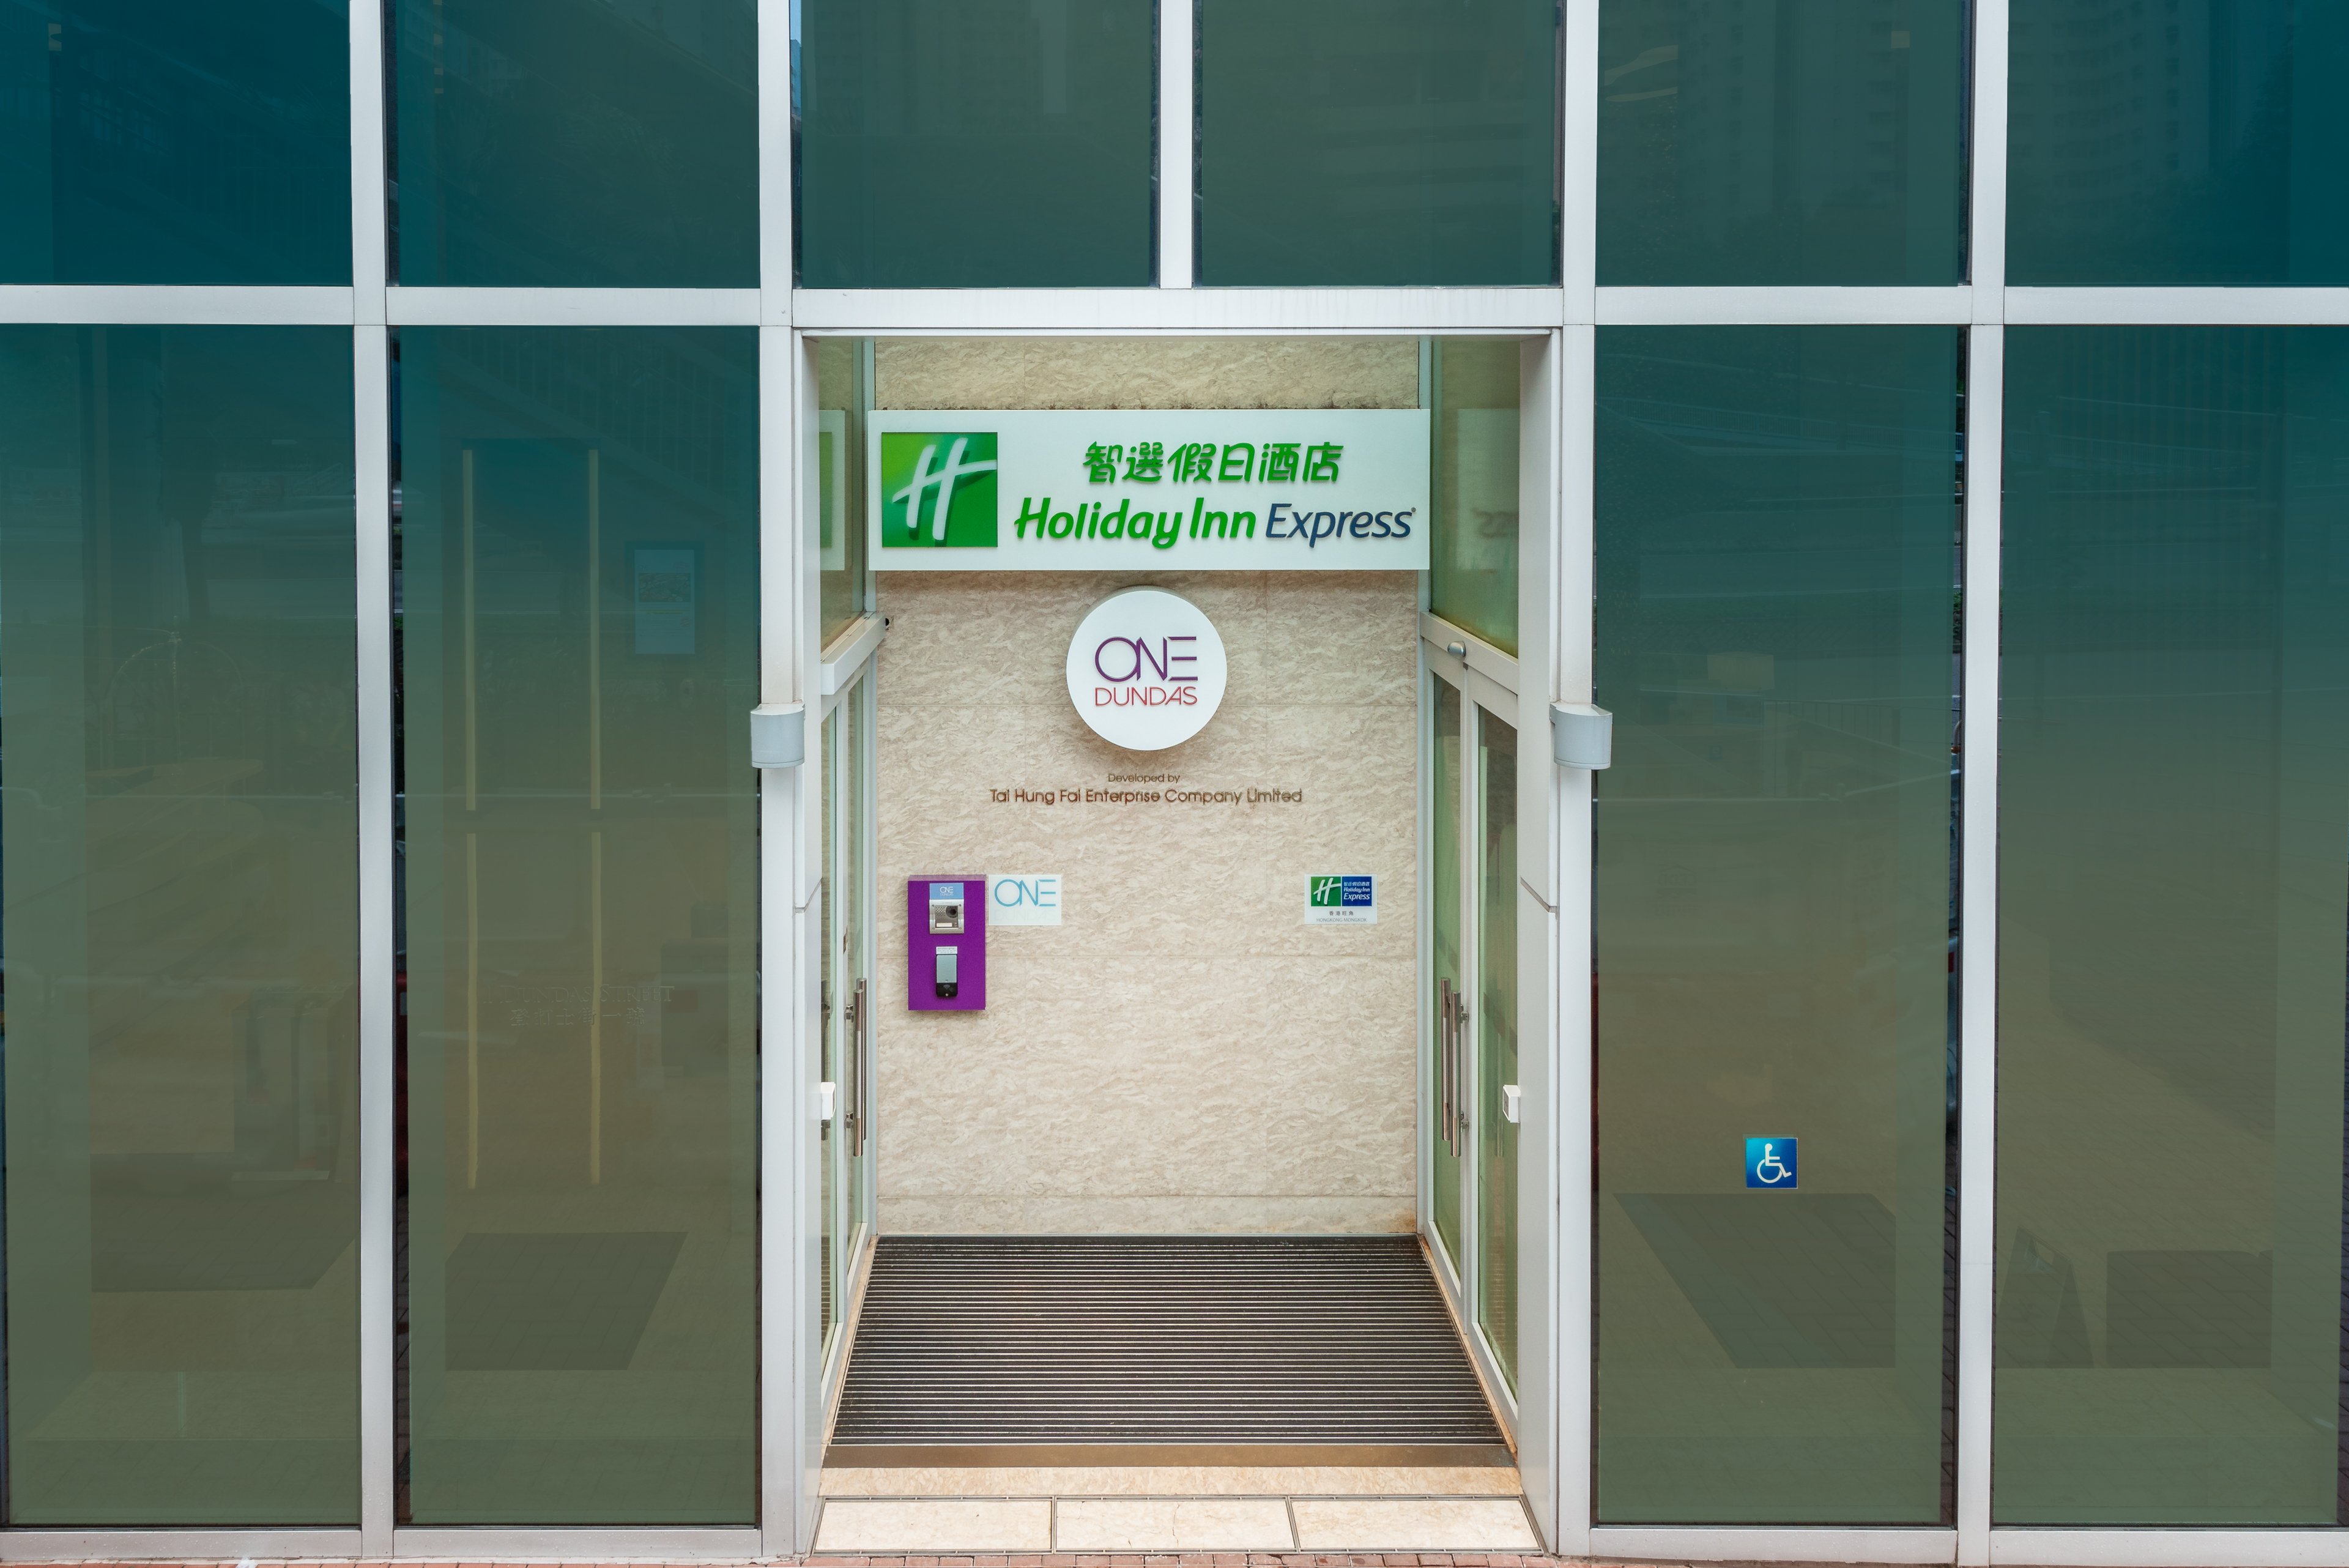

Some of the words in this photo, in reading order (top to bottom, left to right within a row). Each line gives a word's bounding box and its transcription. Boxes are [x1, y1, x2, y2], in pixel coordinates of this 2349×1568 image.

[1082, 440, 1344, 485] 智選假日酒店
[1014, 497, 1182, 550] Holiday
[1189, 497, 1256, 540] Inn
[1265, 503, 1414, 549] Express
[1094, 636, 1198, 682] ONE
[1095, 686, 1198, 707] DUNDAS
[1108, 773, 1165, 784] Developed
[1167, 773, 1180, 784] by
[990, 789, 1010, 803] Tai
[1015, 789, 1055, 804] Hung
[1060, 789, 1082, 803] Fai
[1086, 789, 1160, 805] Enterprise
[1165, 789, 1242, 806] Company
[1247, 788, 1302, 803] Limited
[995, 879, 1056, 907] ONE
[1343, 893, 1370, 902] Express
[499, 985, 593, 1003] DUNDAS
[599, 984, 675, 1003] STREET
